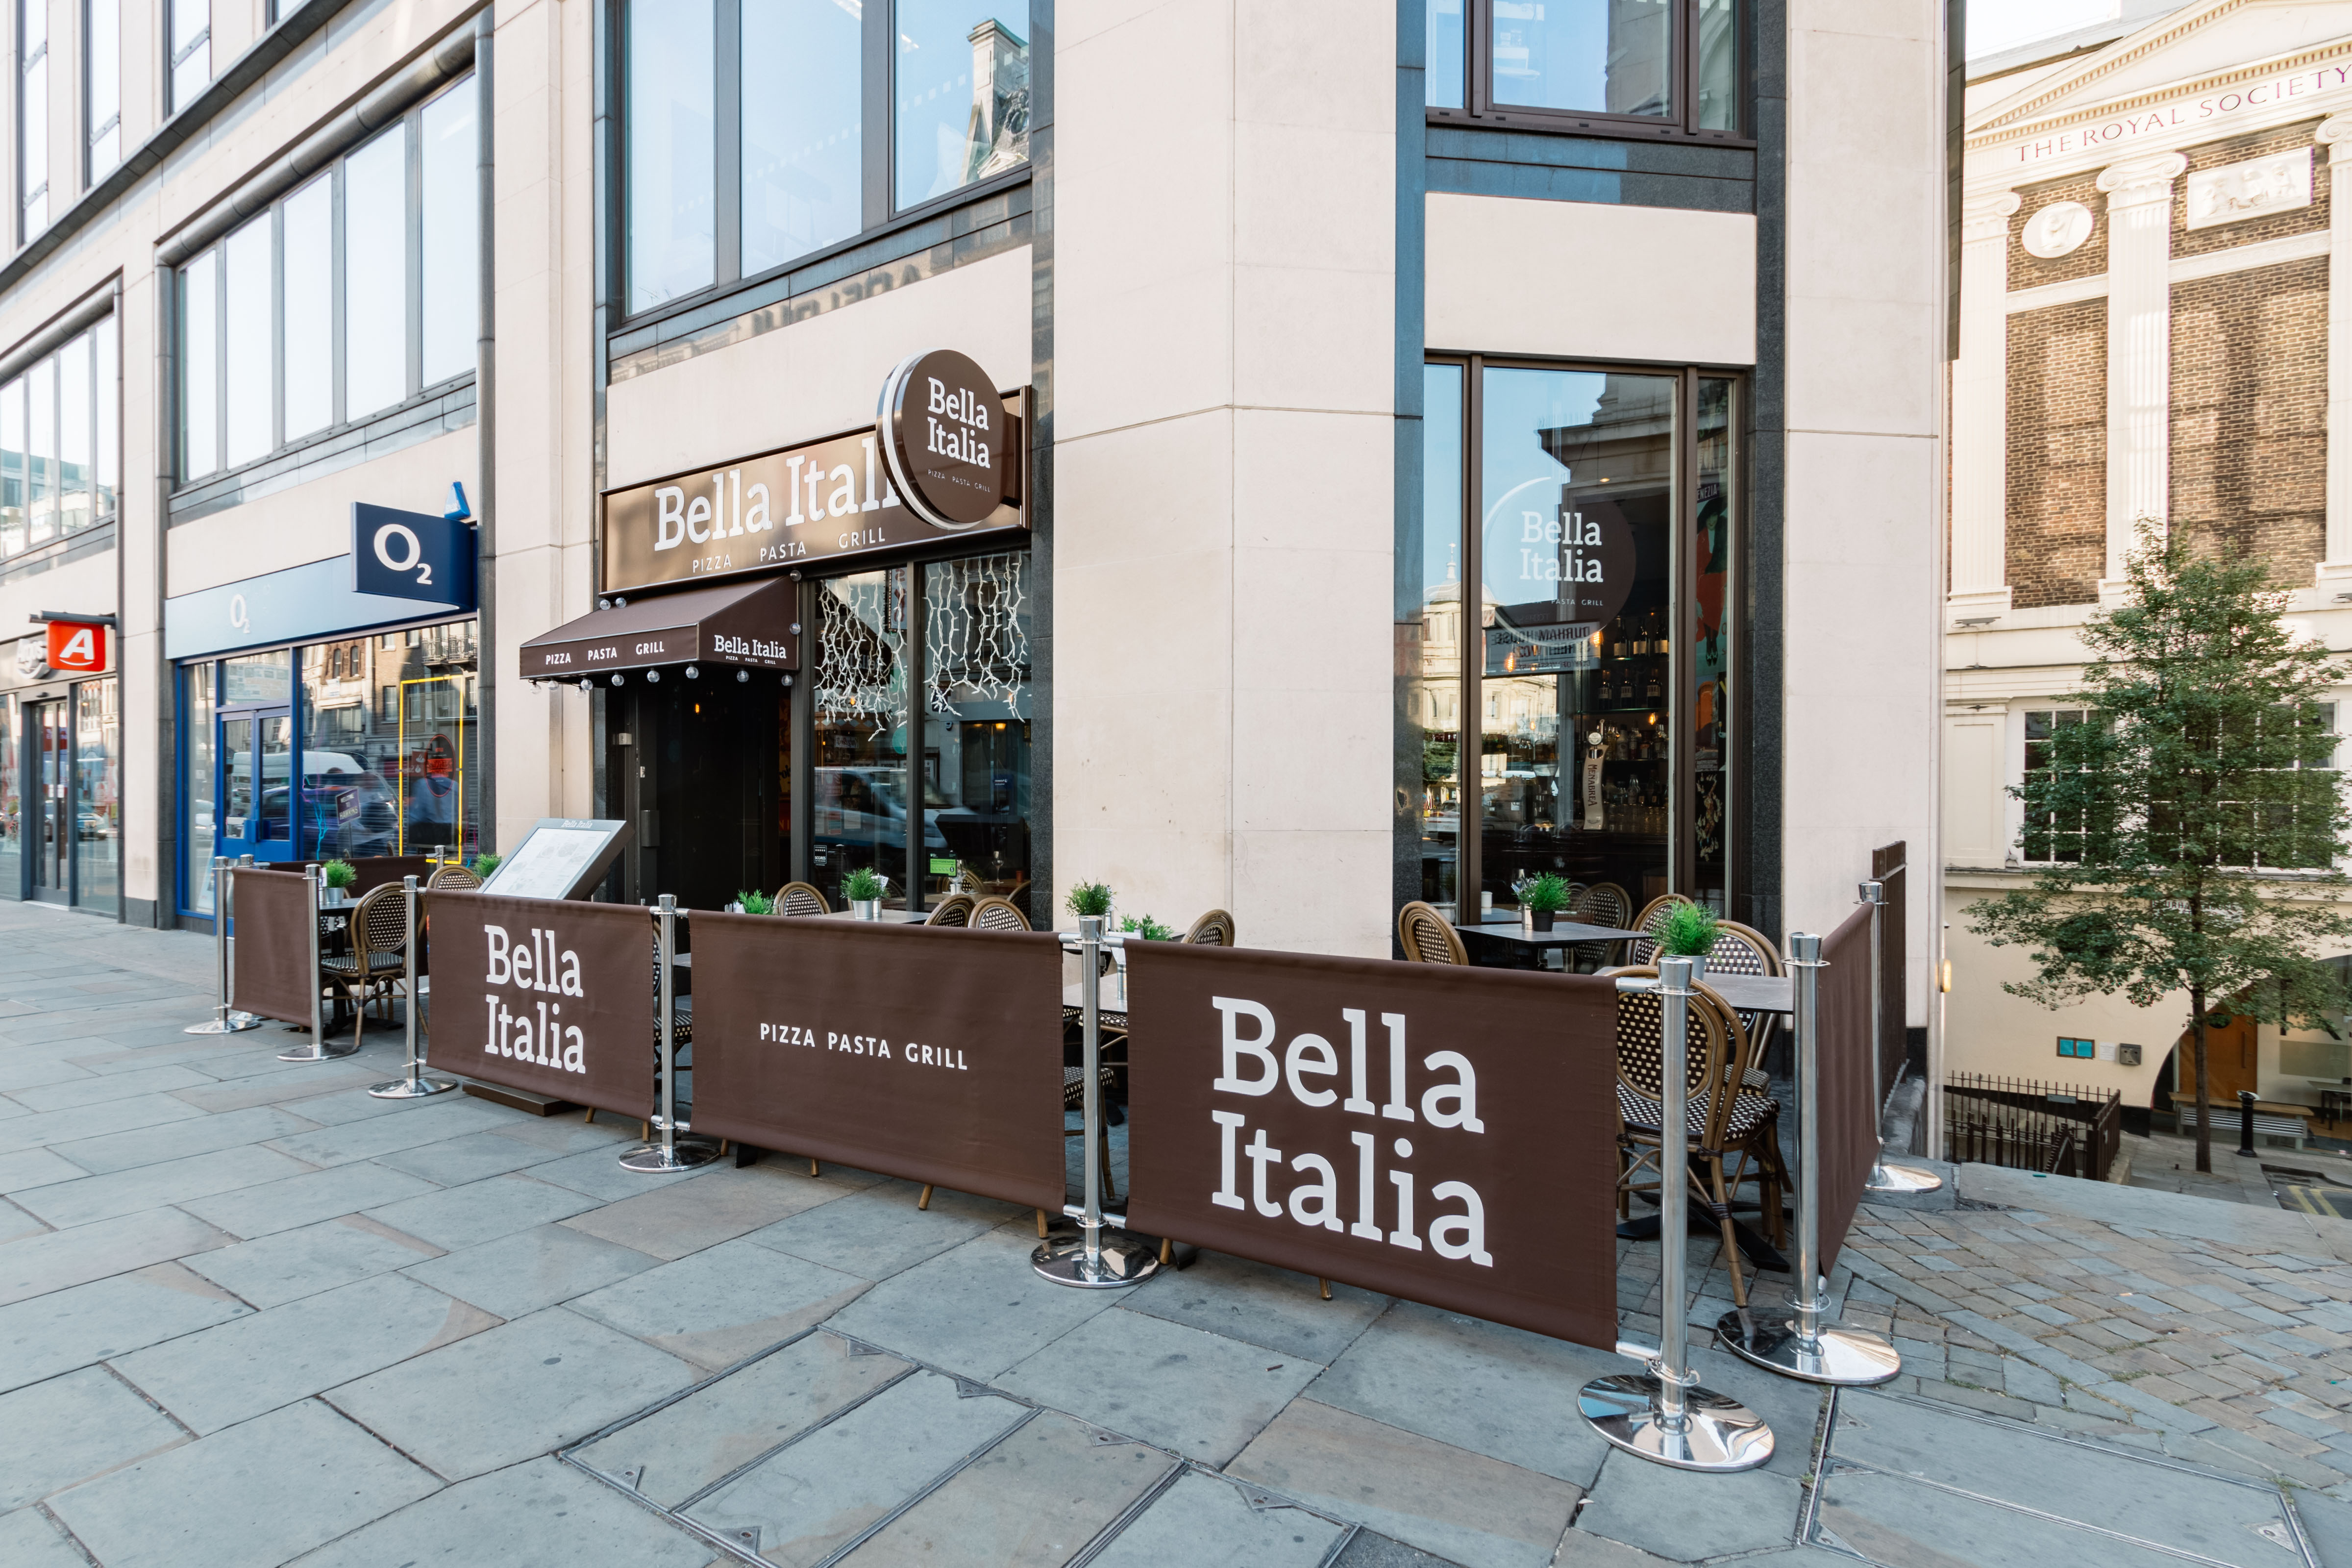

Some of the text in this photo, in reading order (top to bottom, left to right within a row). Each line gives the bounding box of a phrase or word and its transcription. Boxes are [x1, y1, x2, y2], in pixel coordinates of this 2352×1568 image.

[2015, 64, 2352, 161] THE ROYAL SOCIETY
[927, 376, 989, 431] Bella
[927, 416, 990, 469] Italia
[654, 436, 901, 551] Bella Ital
[928, 469, 990, 493] PIZZA PASTA GRILL
[1697, 483, 1717, 500] ENEZIA
[692, 527, 886, 573] PIZZA PASTA GRILL
[1521, 511, 1602, 546] Bella
[374, 523, 432, 585] O2
[1519, 548, 1604, 583] Italia
[59, 629, 95, 660] A
[545, 641, 665, 665] PIZZA PASTA GRILL
[714, 634, 787, 659] Bella Italia
[1587, 764, 1598, 806] MENABREA
[484, 924, 584, 998] Bella
[484, 994, 586, 1074] Italia
[760, 1023, 967, 1070] PIZZA PASTA GRILL
[1212, 996, 1485, 1134] Bella
[1212, 1109, 1493, 1268] Italia
